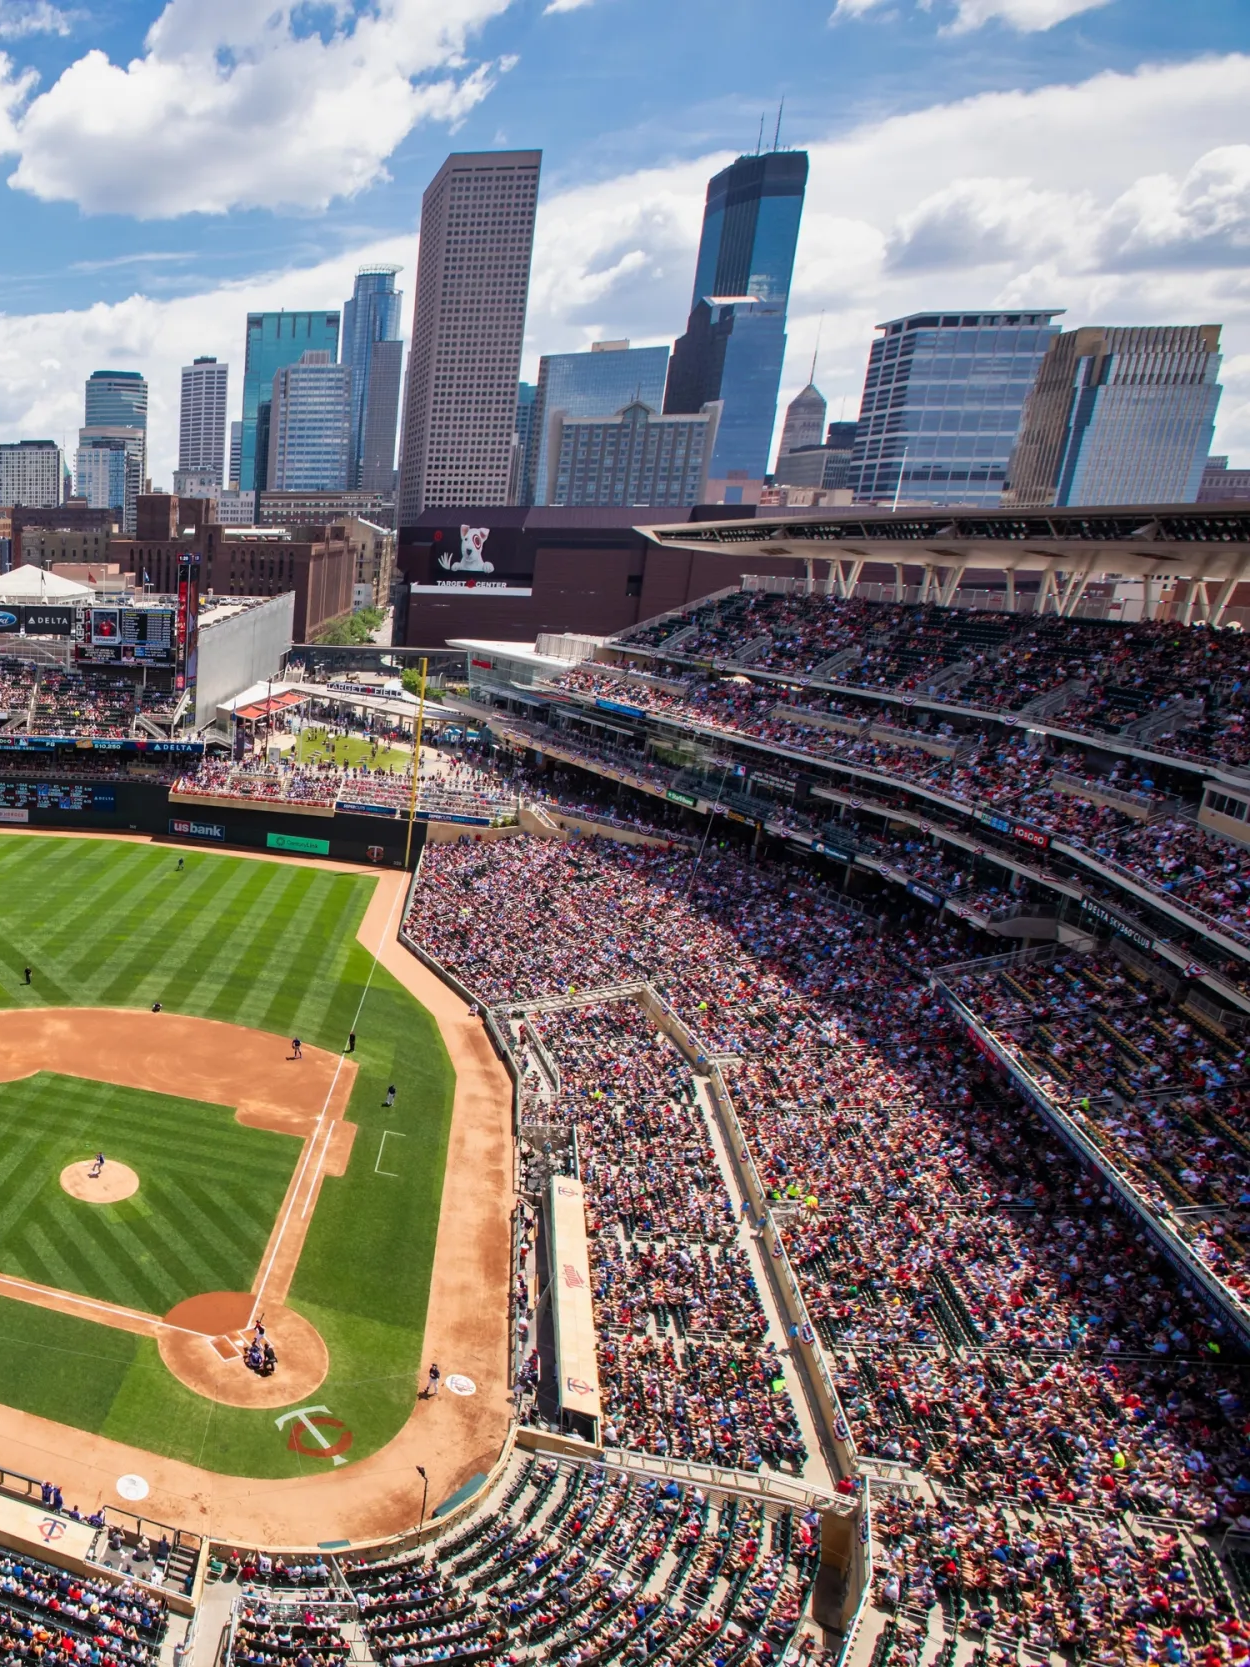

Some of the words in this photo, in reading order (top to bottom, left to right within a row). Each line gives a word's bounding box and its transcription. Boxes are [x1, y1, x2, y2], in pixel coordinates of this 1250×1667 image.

[437, 580, 466, 588] TARGET
[37, 617, 68, 625] DELTA
[76, 607, 85, 643] KEPLER
[1087, 901, 1109, 922] DELTA
[1133, 932, 1150, 949] CLUB
[1112, 1190, 1141, 1225] DELTA
[563, 1263, 585, 1289] Twins
